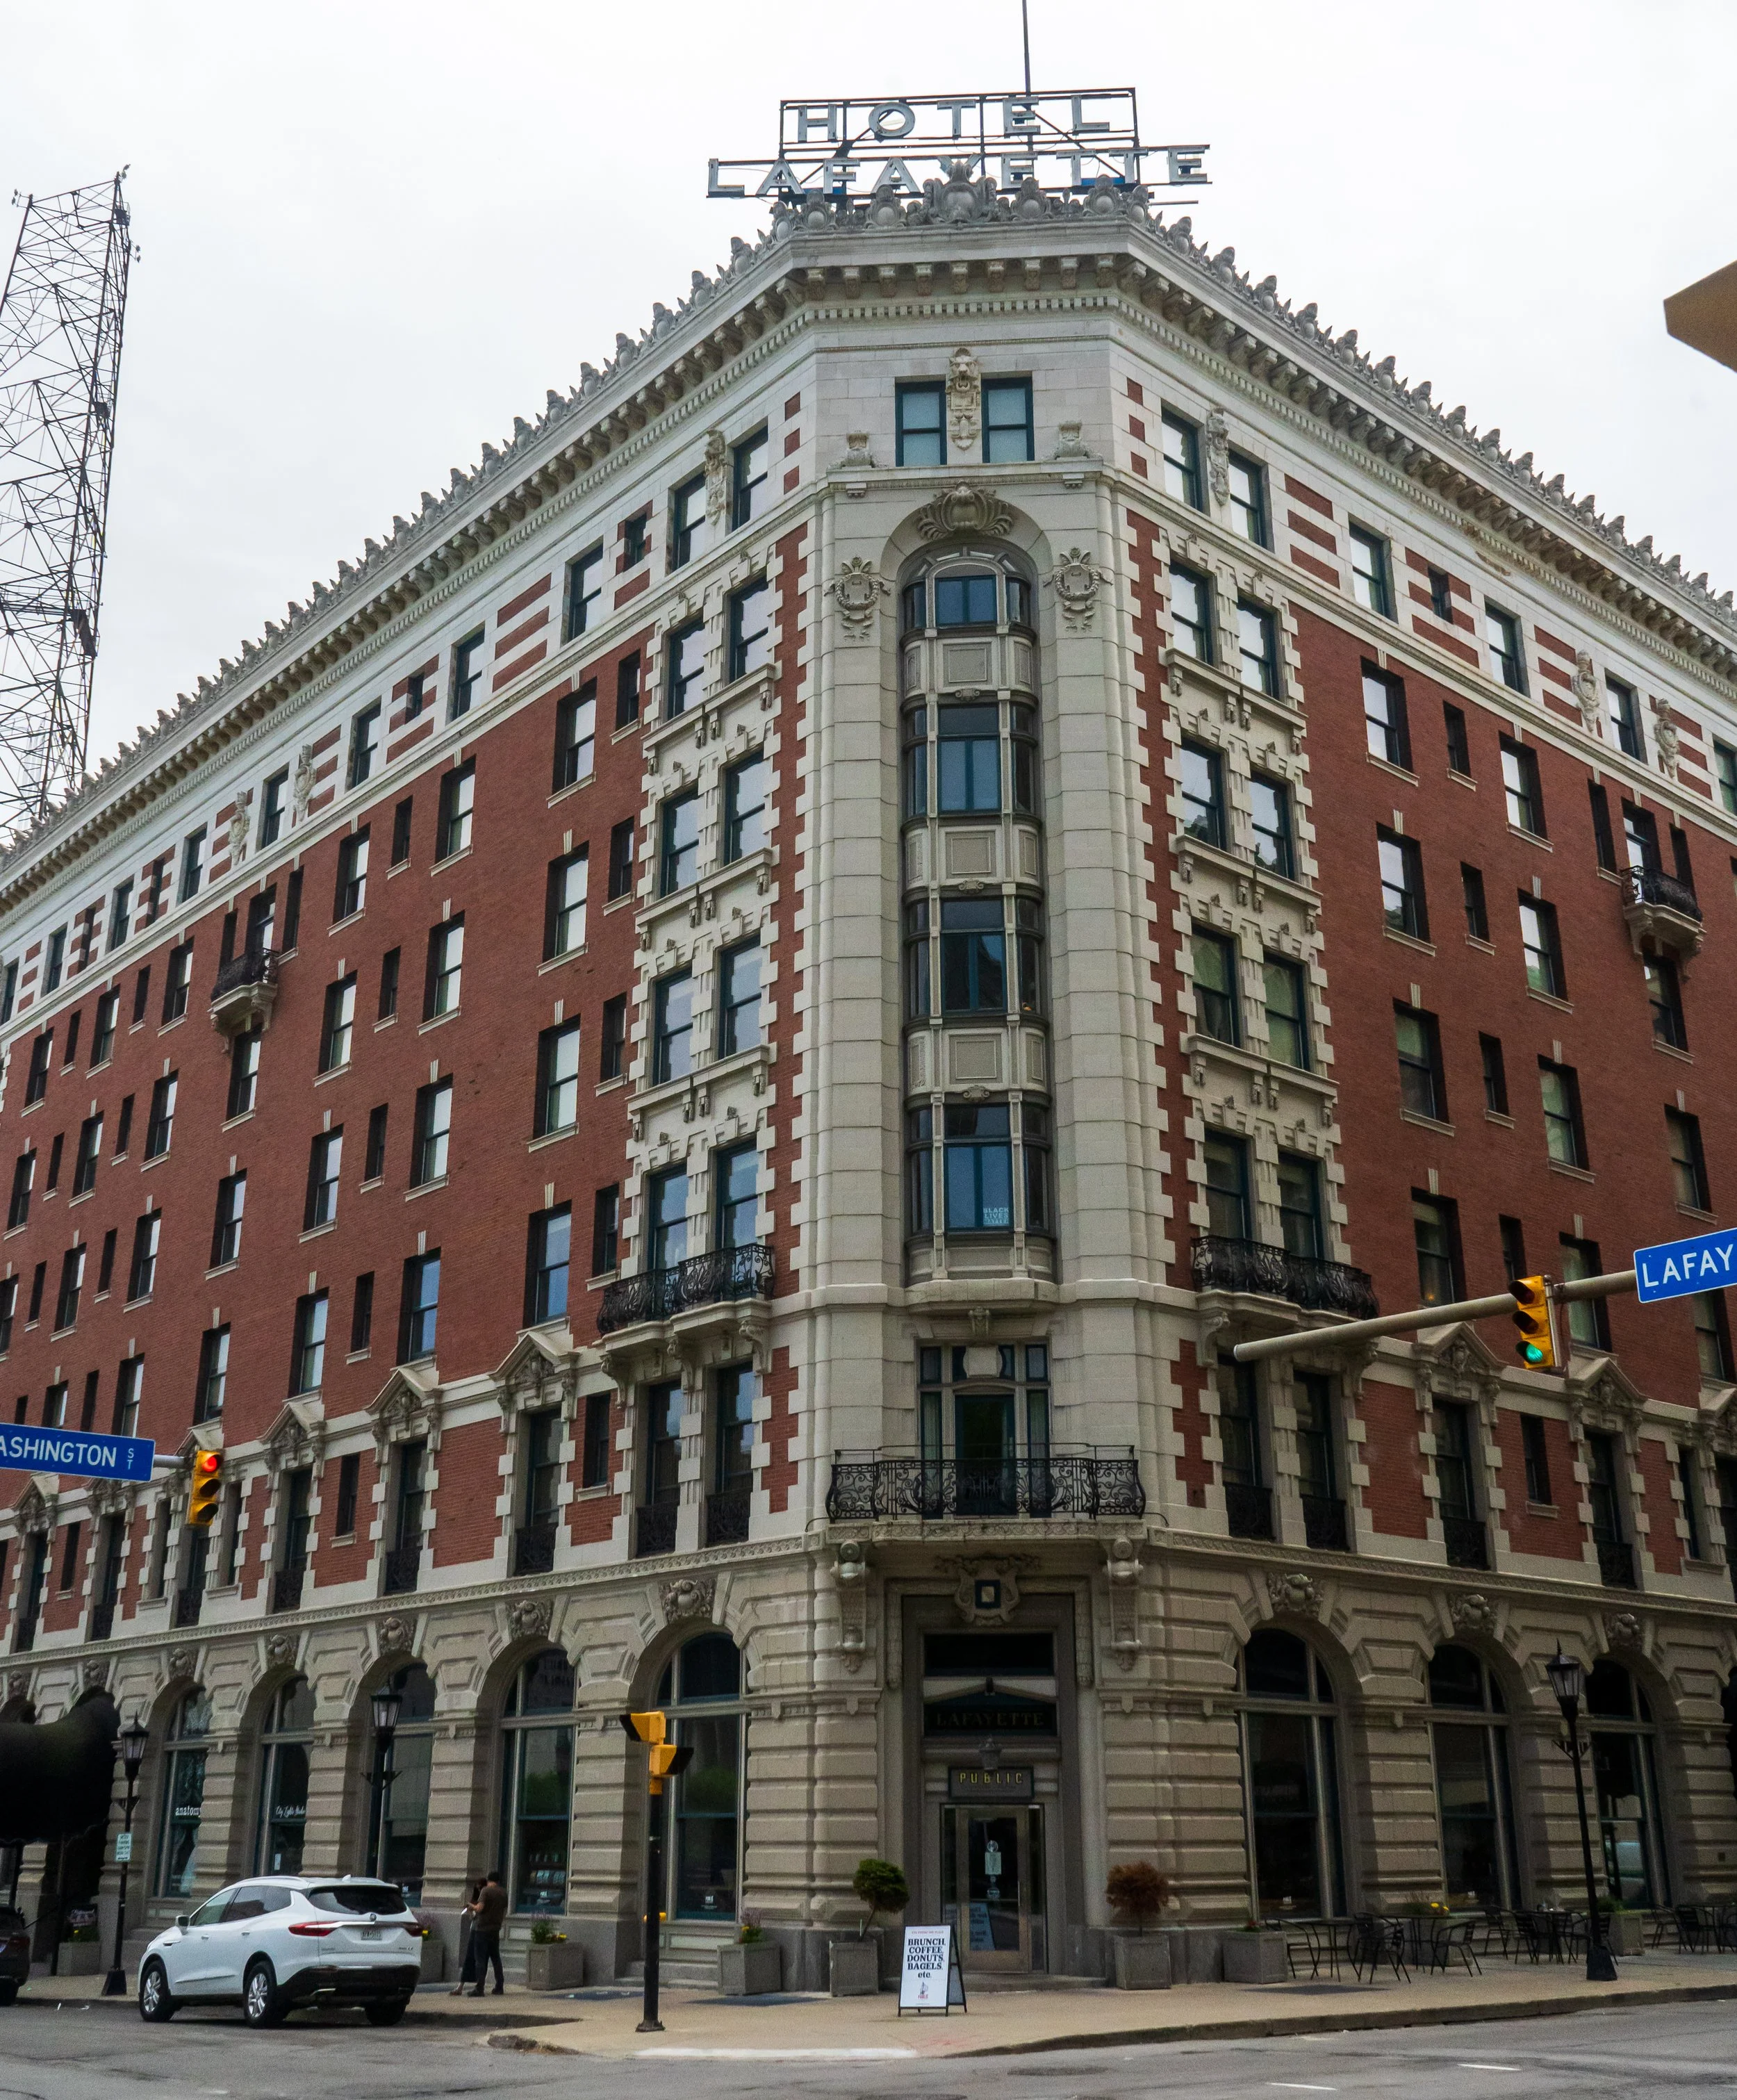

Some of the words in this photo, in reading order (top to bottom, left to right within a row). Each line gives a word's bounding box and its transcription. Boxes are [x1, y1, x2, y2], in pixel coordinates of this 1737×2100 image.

[797, 95, 1110, 144] HOTEL
[1642, 1244, 1734, 1288] LAFAY
[936, 1712, 1045, 1728] LAFAYETTE
[959, 1772, 1023, 1785] PUBLIC
